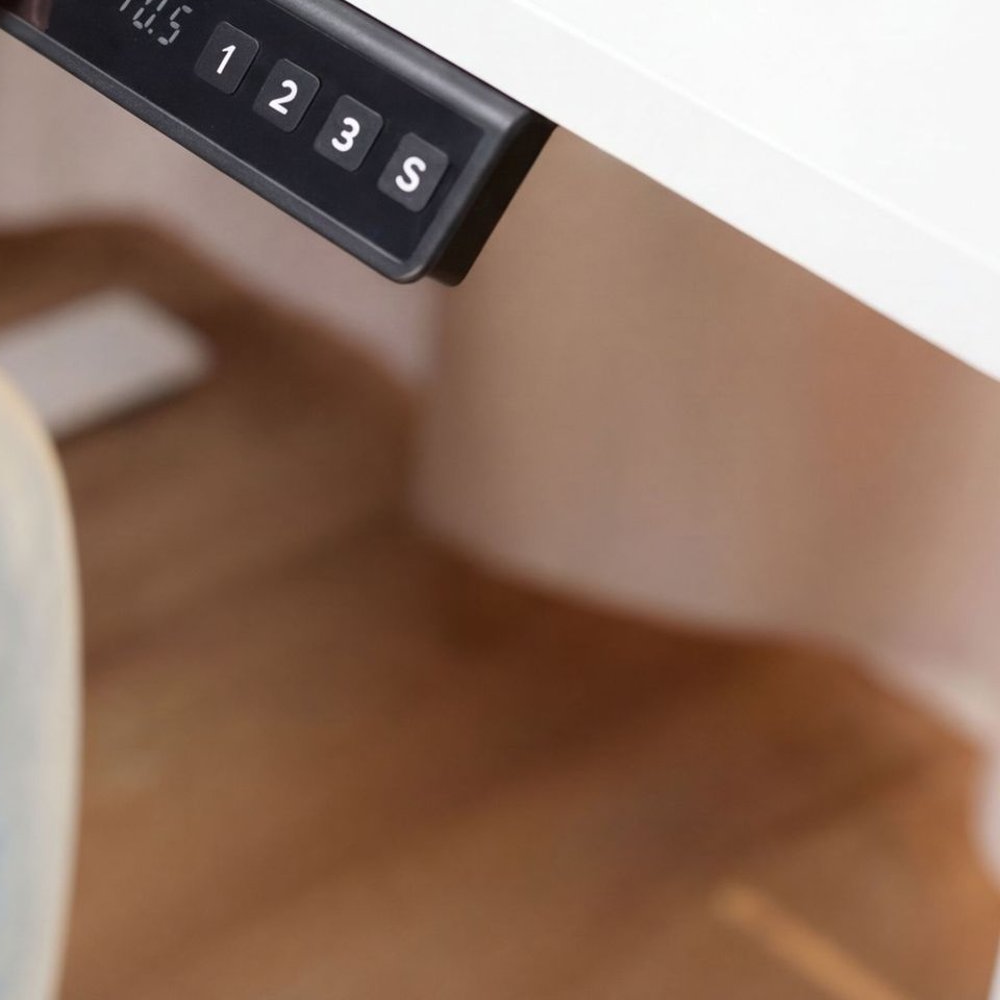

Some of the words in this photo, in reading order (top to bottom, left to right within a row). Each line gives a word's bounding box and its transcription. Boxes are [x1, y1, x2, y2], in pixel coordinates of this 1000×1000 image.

[216, 44, 237, 75] 1
[268, 79, 298, 115] 2
[331, 116, 361, 152] 3
[395, 156, 427, 193] S
